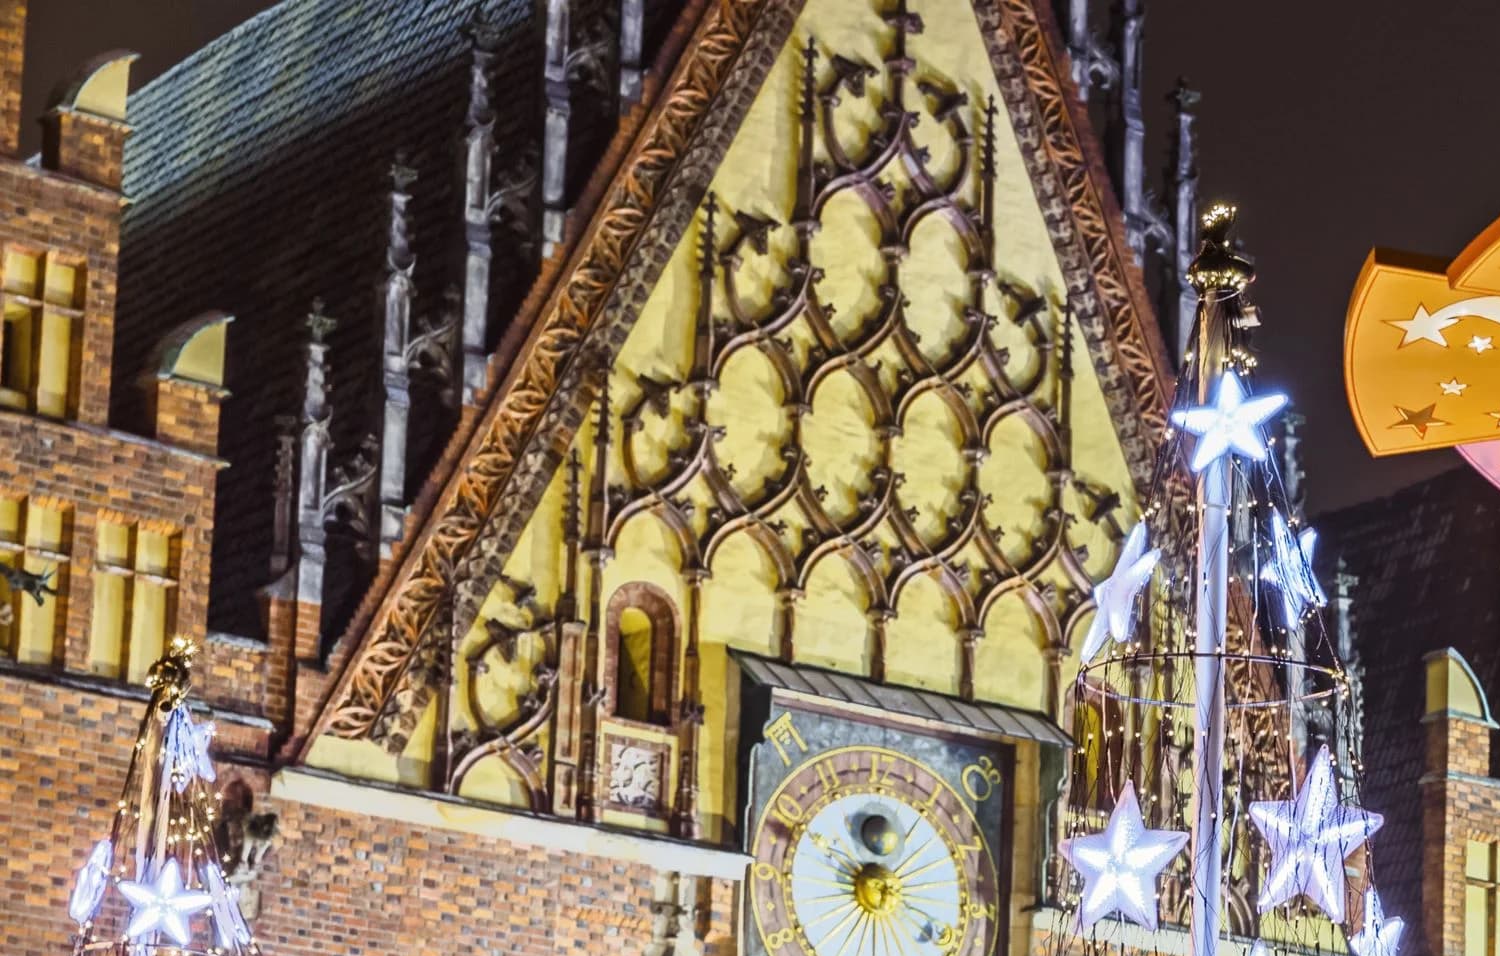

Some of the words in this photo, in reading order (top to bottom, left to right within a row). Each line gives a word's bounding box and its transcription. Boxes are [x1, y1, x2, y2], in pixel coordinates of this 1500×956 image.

[815, 759, 841, 793] 11
[770, 793, 803, 829] 10
[767, 928, 794, 949] 8
